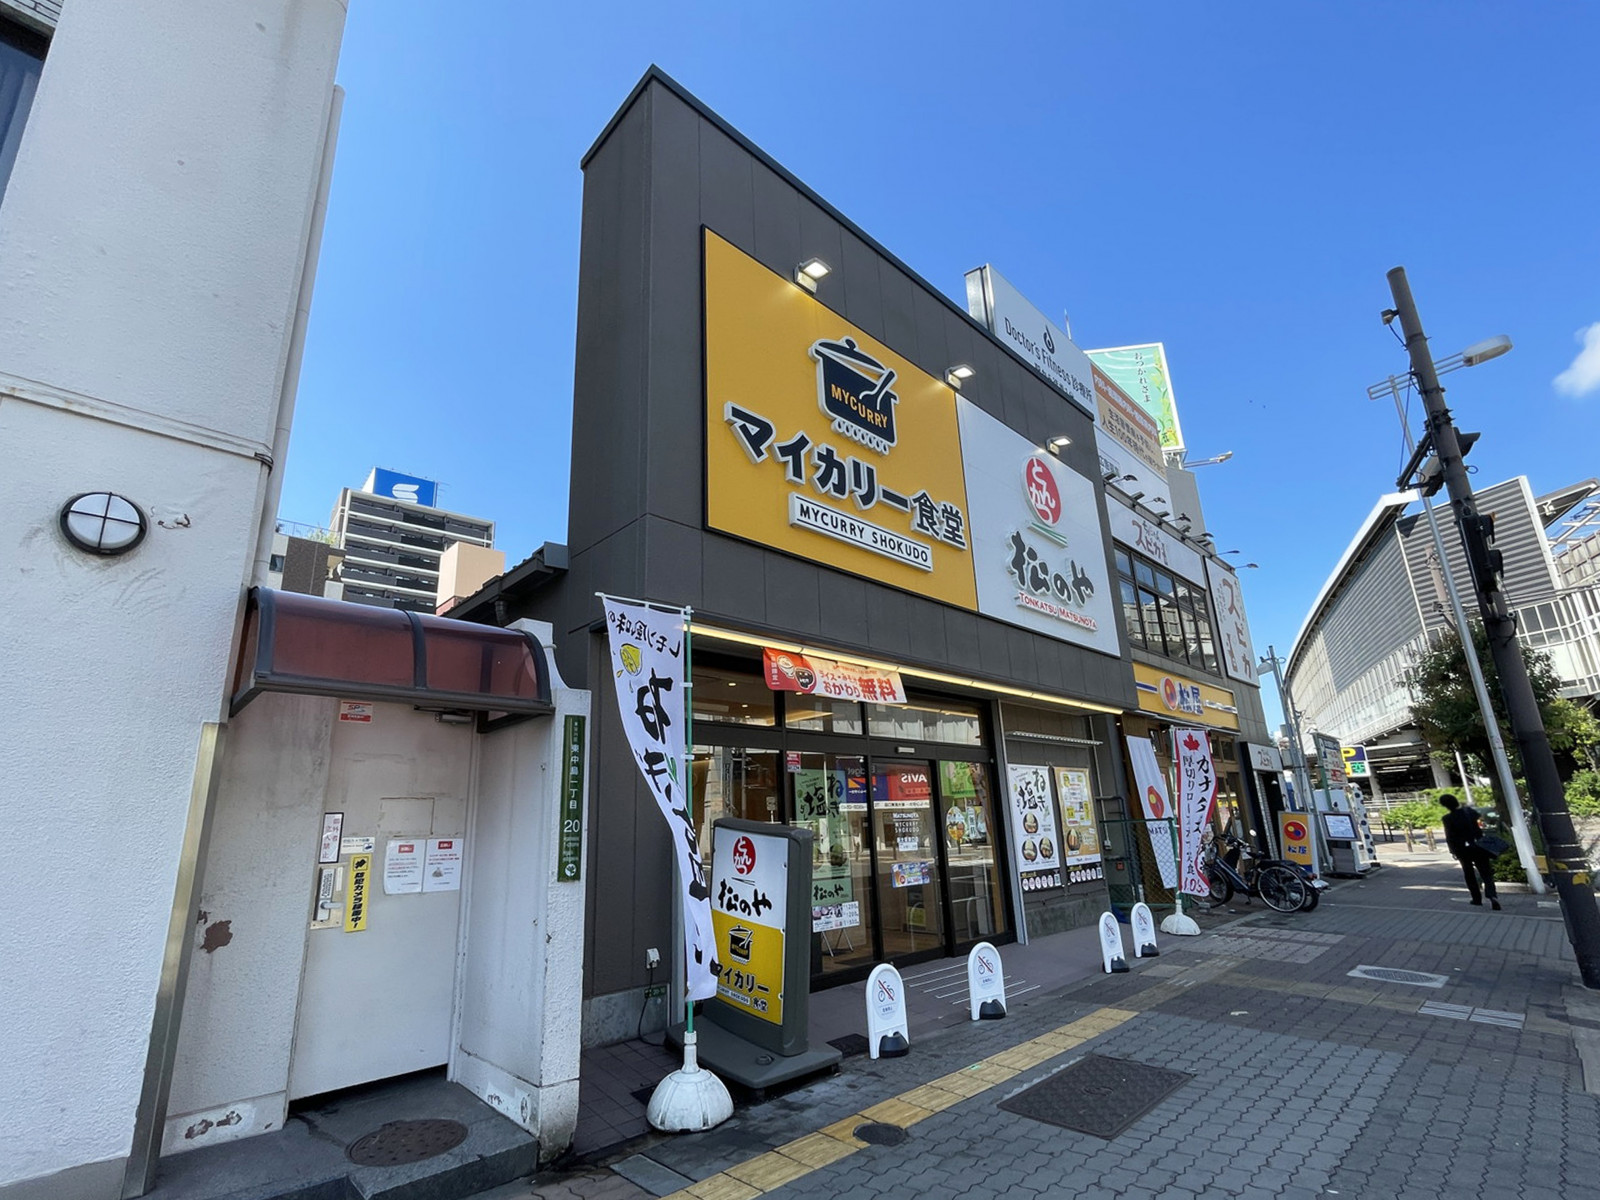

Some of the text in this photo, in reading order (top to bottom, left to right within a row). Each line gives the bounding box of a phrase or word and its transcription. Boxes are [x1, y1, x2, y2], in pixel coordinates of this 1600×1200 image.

[1004, 317, 1041, 361] Doctor's
[1041, 348, 1071, 386] Fitness
[831, 383, 889, 429] MYCURRY
[729, 403, 966, 549] マイカリー食堂
[799, 503, 929, 564] MYCURRY SHOKUDO
[1010, 530, 1095, 606] 松のや
[1019, 592, 1097, 629] TONKATSU MATSUNOYA
[563, 819, 580, 833] 20
[718, 878, 772, 917] 松のや
[813, 882, 844, 901] 松のや
